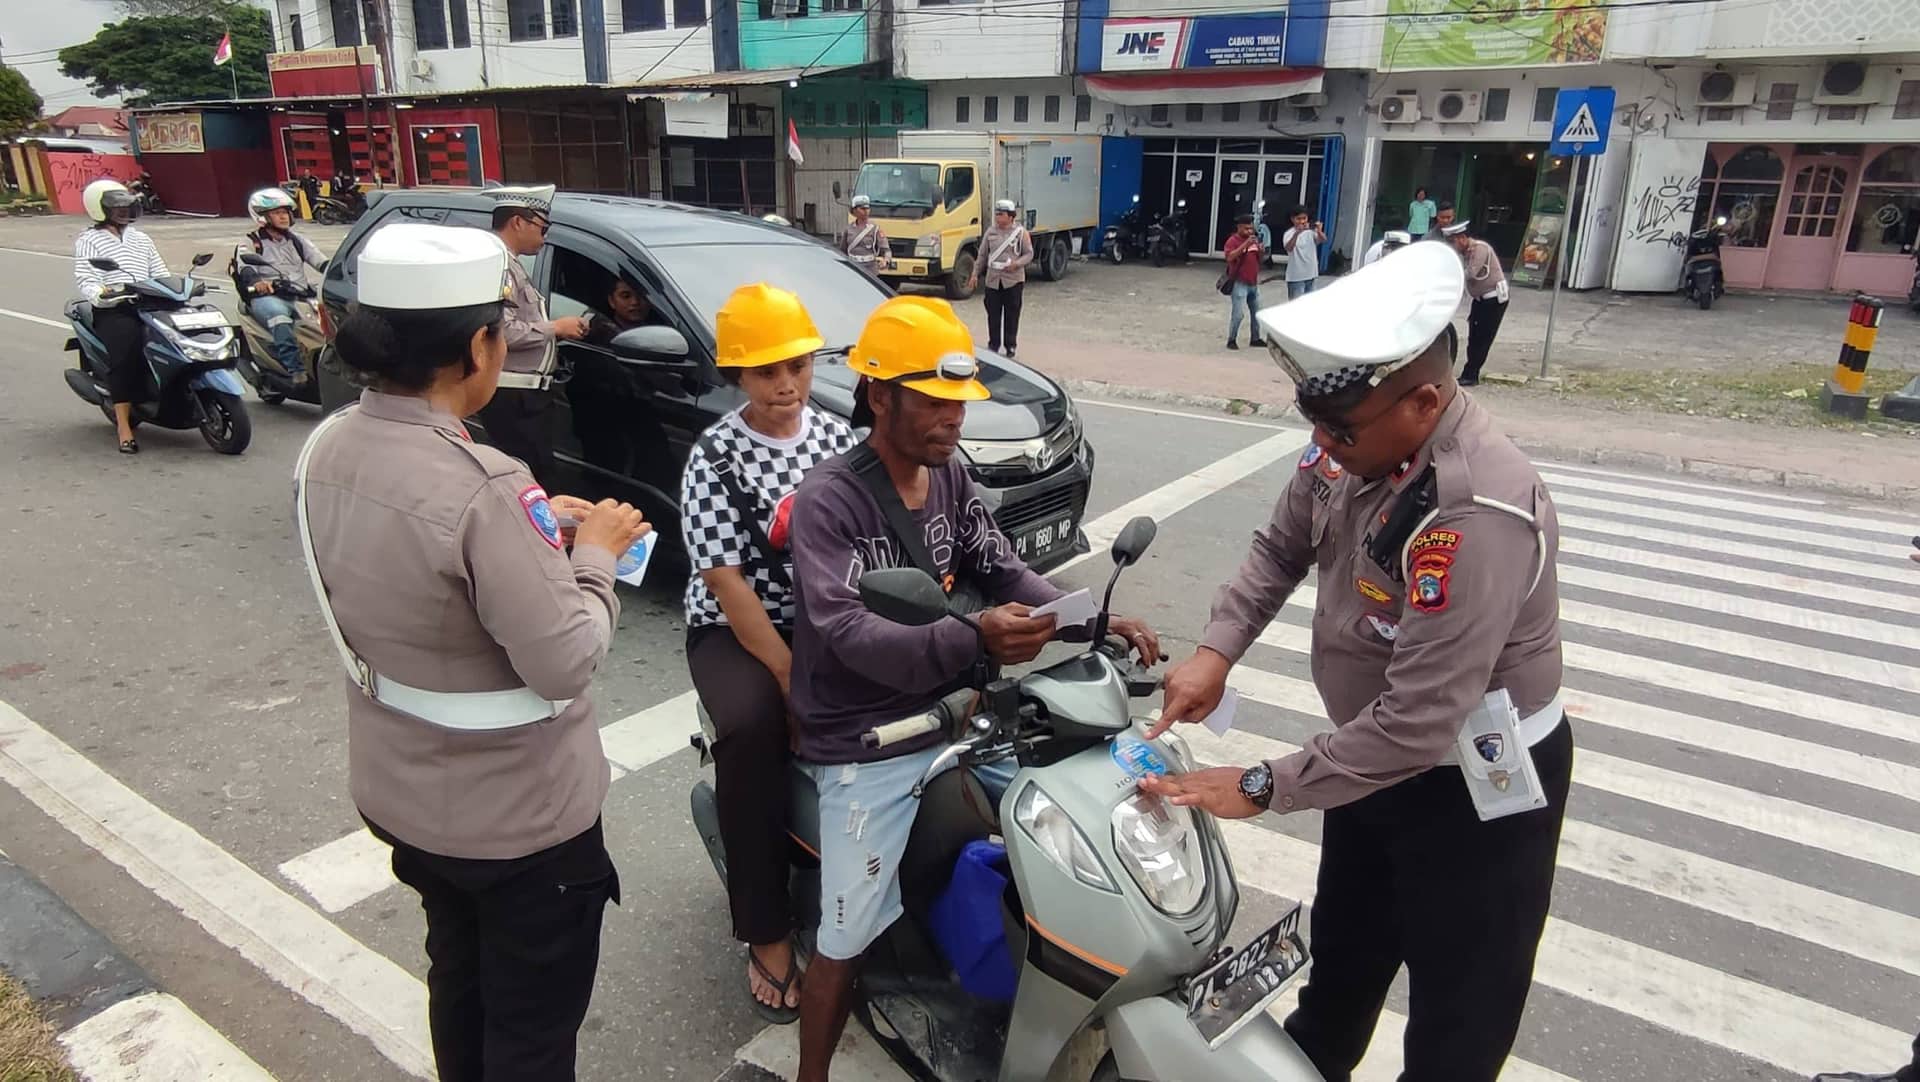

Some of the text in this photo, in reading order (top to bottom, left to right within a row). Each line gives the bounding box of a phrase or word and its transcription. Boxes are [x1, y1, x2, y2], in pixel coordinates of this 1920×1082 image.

[1116, 31, 1166, 55] JNE
[1228, 35, 1281, 47] CABANG TIMIKA
[1050, 156, 1073, 177] JNE
[1016, 535, 1027, 558] PA
[1058, 519, 1071, 540] MP
[1190, 976, 1216, 1012] PA
[1225, 933, 1270, 986] 3822
